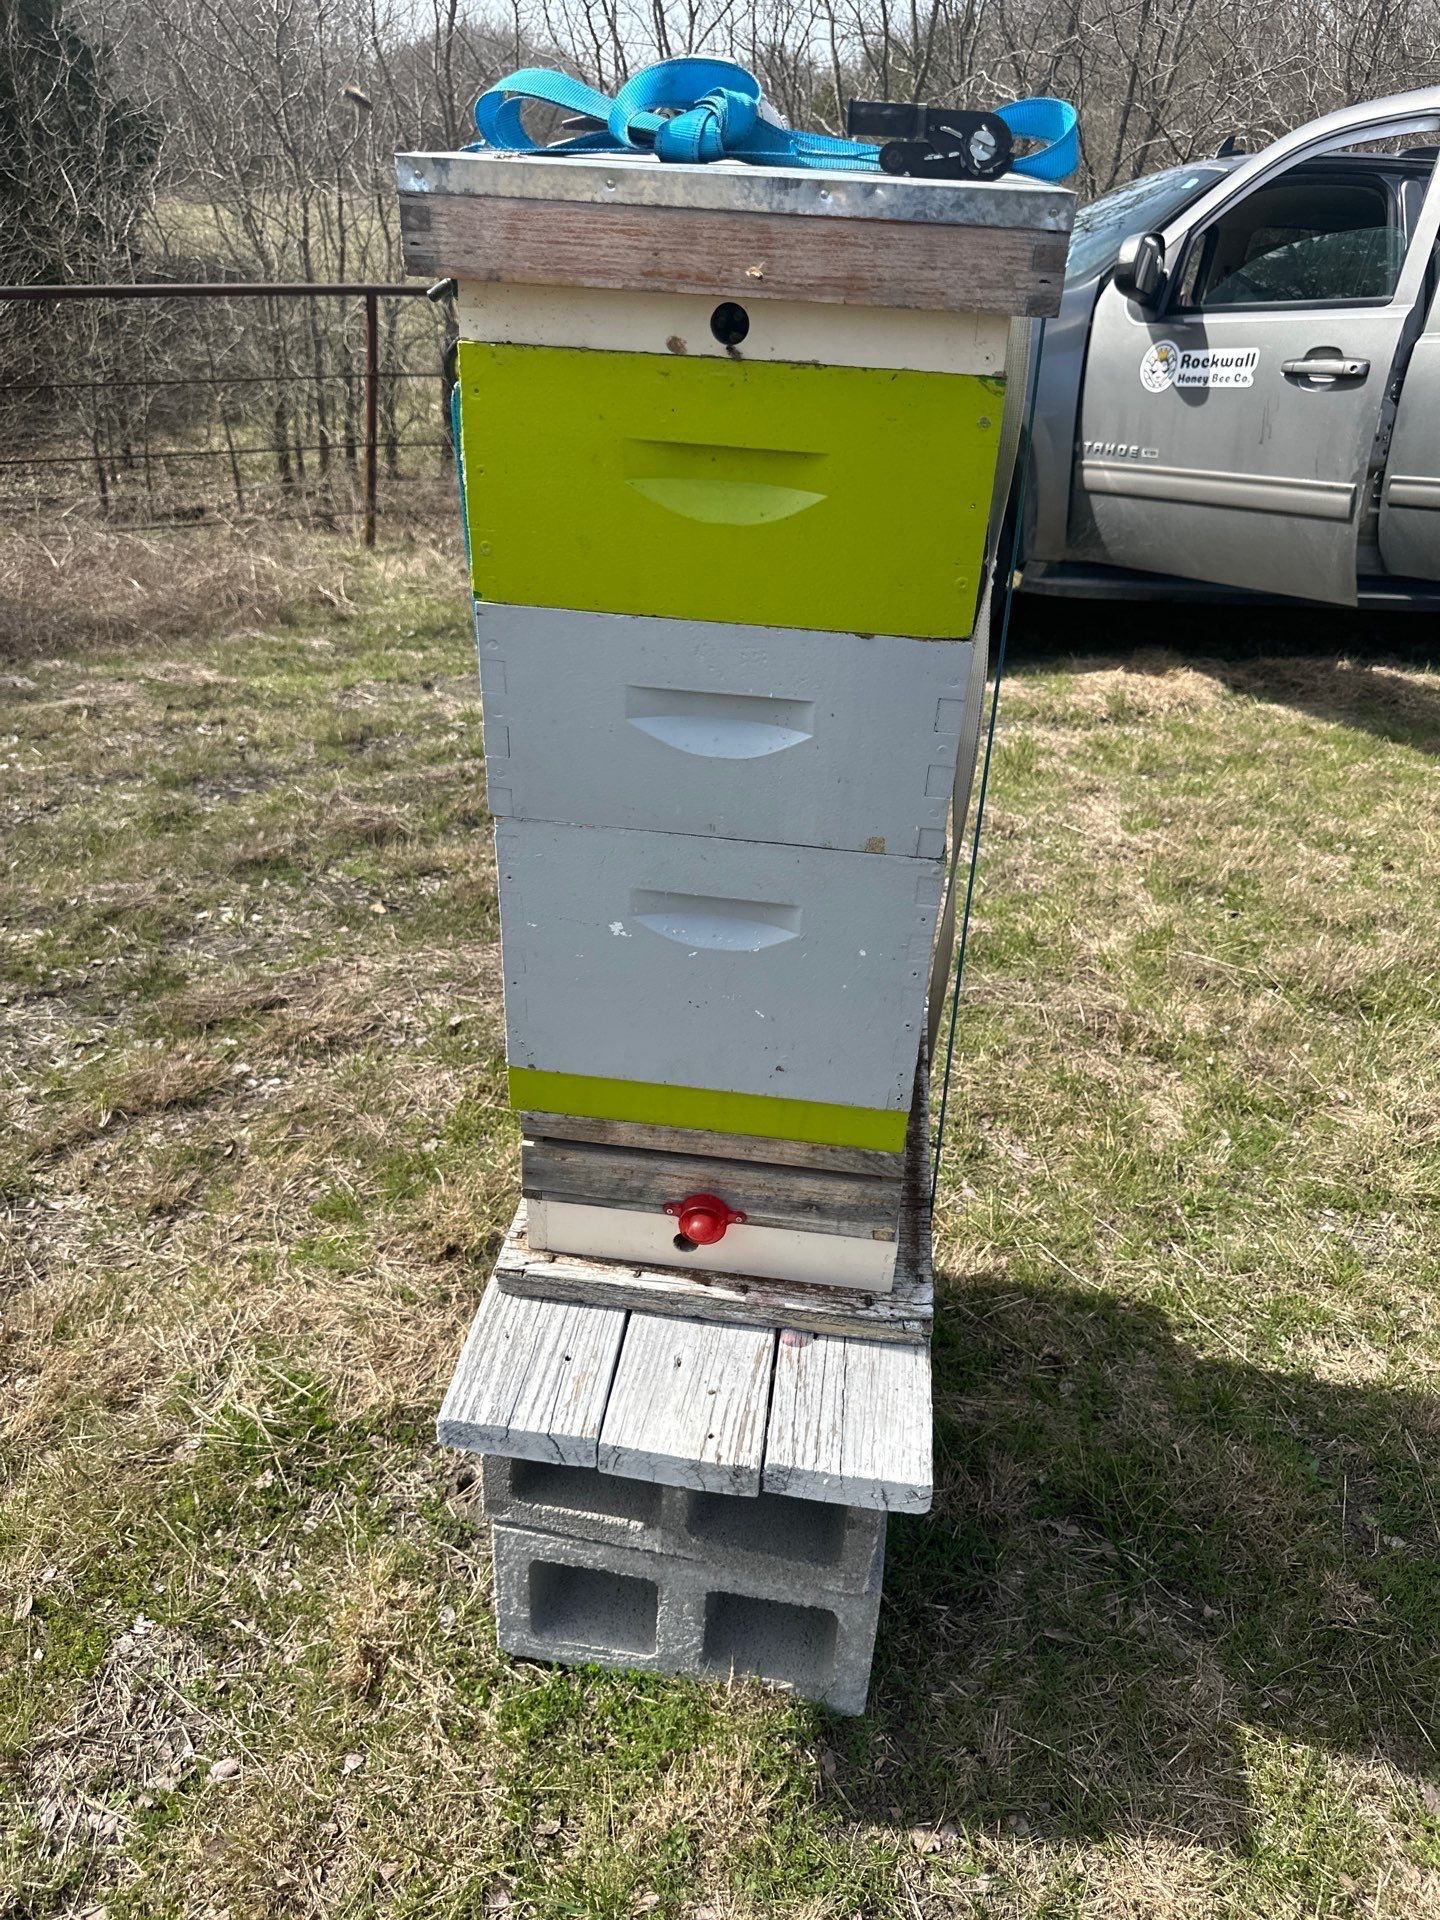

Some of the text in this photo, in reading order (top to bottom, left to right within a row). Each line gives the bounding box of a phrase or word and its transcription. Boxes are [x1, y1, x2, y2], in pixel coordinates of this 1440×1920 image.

[1180, 352, 1256, 369] Rockwall
[1177, 373, 1251, 386] Honey Bee Co.
[1083, 441, 1139, 458] TAHOE
